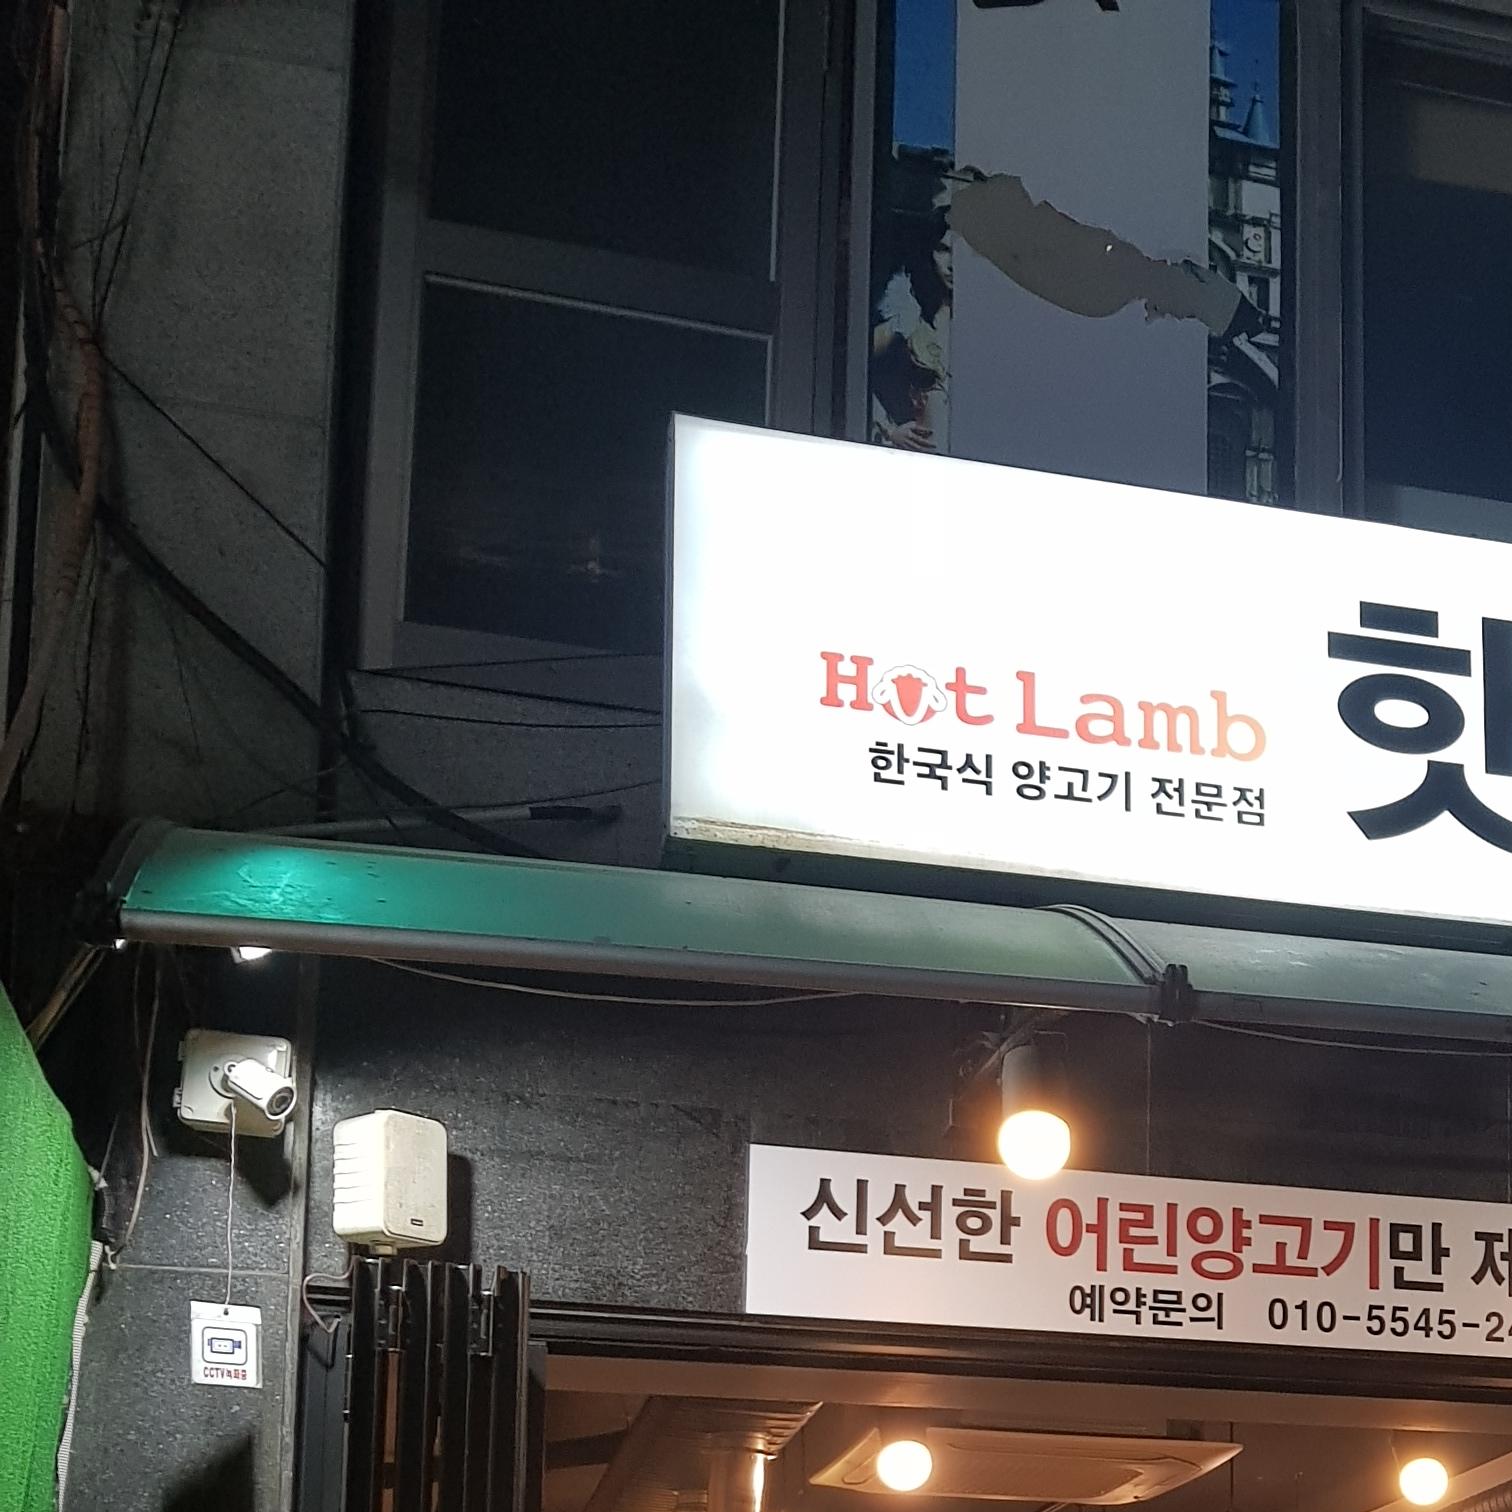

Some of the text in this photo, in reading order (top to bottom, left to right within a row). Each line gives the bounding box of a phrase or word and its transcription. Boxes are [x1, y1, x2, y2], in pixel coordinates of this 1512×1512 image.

[819, 651, 1267, 763] Hot Lamb
[868, 740, 1266, 827] 한국식 양고기 전문점
[800, 1177, 1021, 1264] 신선한
[1045, 1196, 1450, 1292] 어린양고기만
[1069, 1283, 1224, 1330] 예약문의
